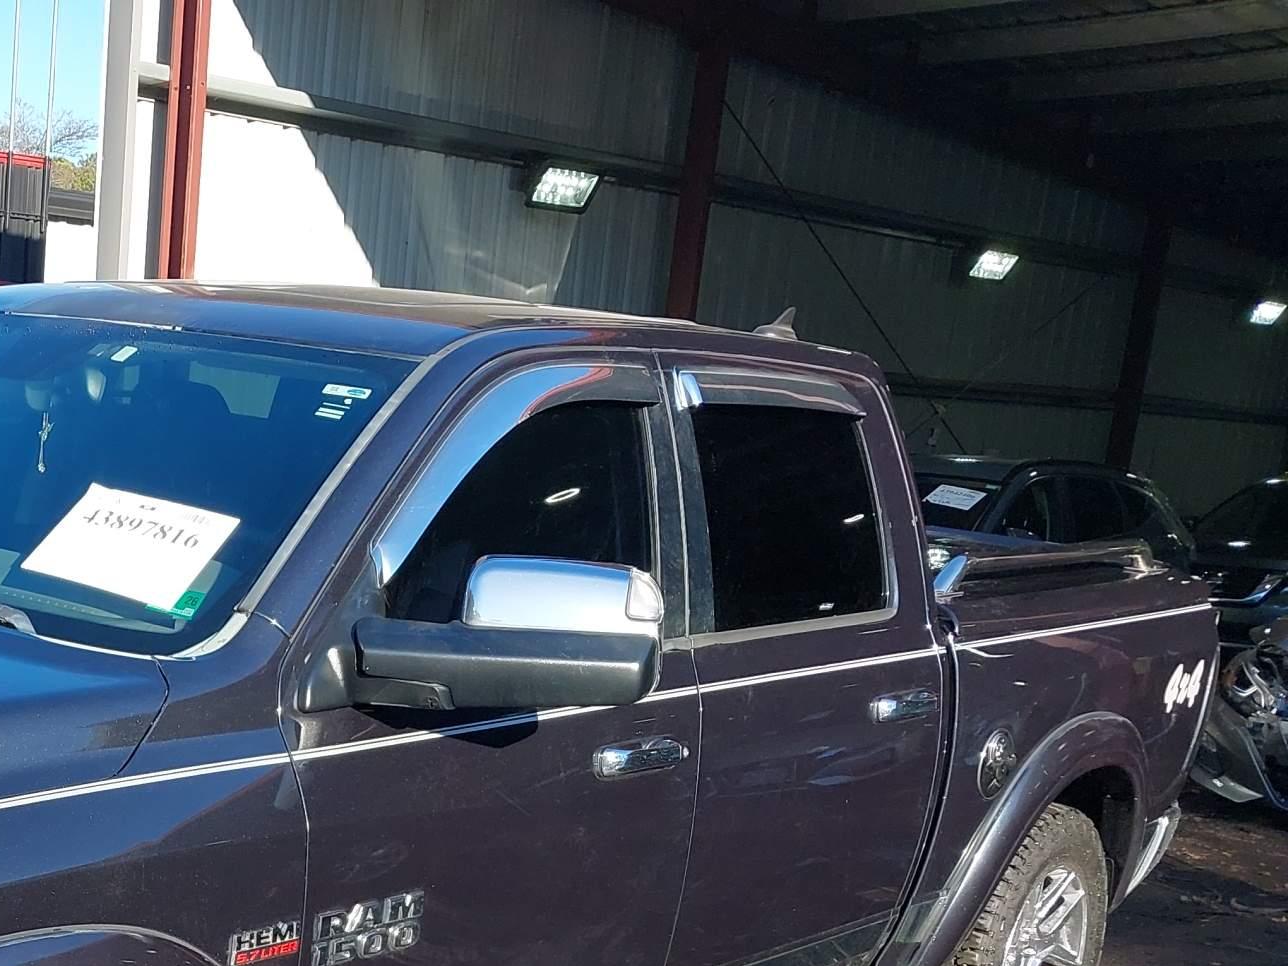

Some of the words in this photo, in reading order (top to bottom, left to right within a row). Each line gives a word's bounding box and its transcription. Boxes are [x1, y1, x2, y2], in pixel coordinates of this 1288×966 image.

[83, 508, 200, 549] 43897816
[314, 889, 424, 940] RAM
[236, 950, 259, 965] 5.7
[260, 940, 299, 960] LITER
